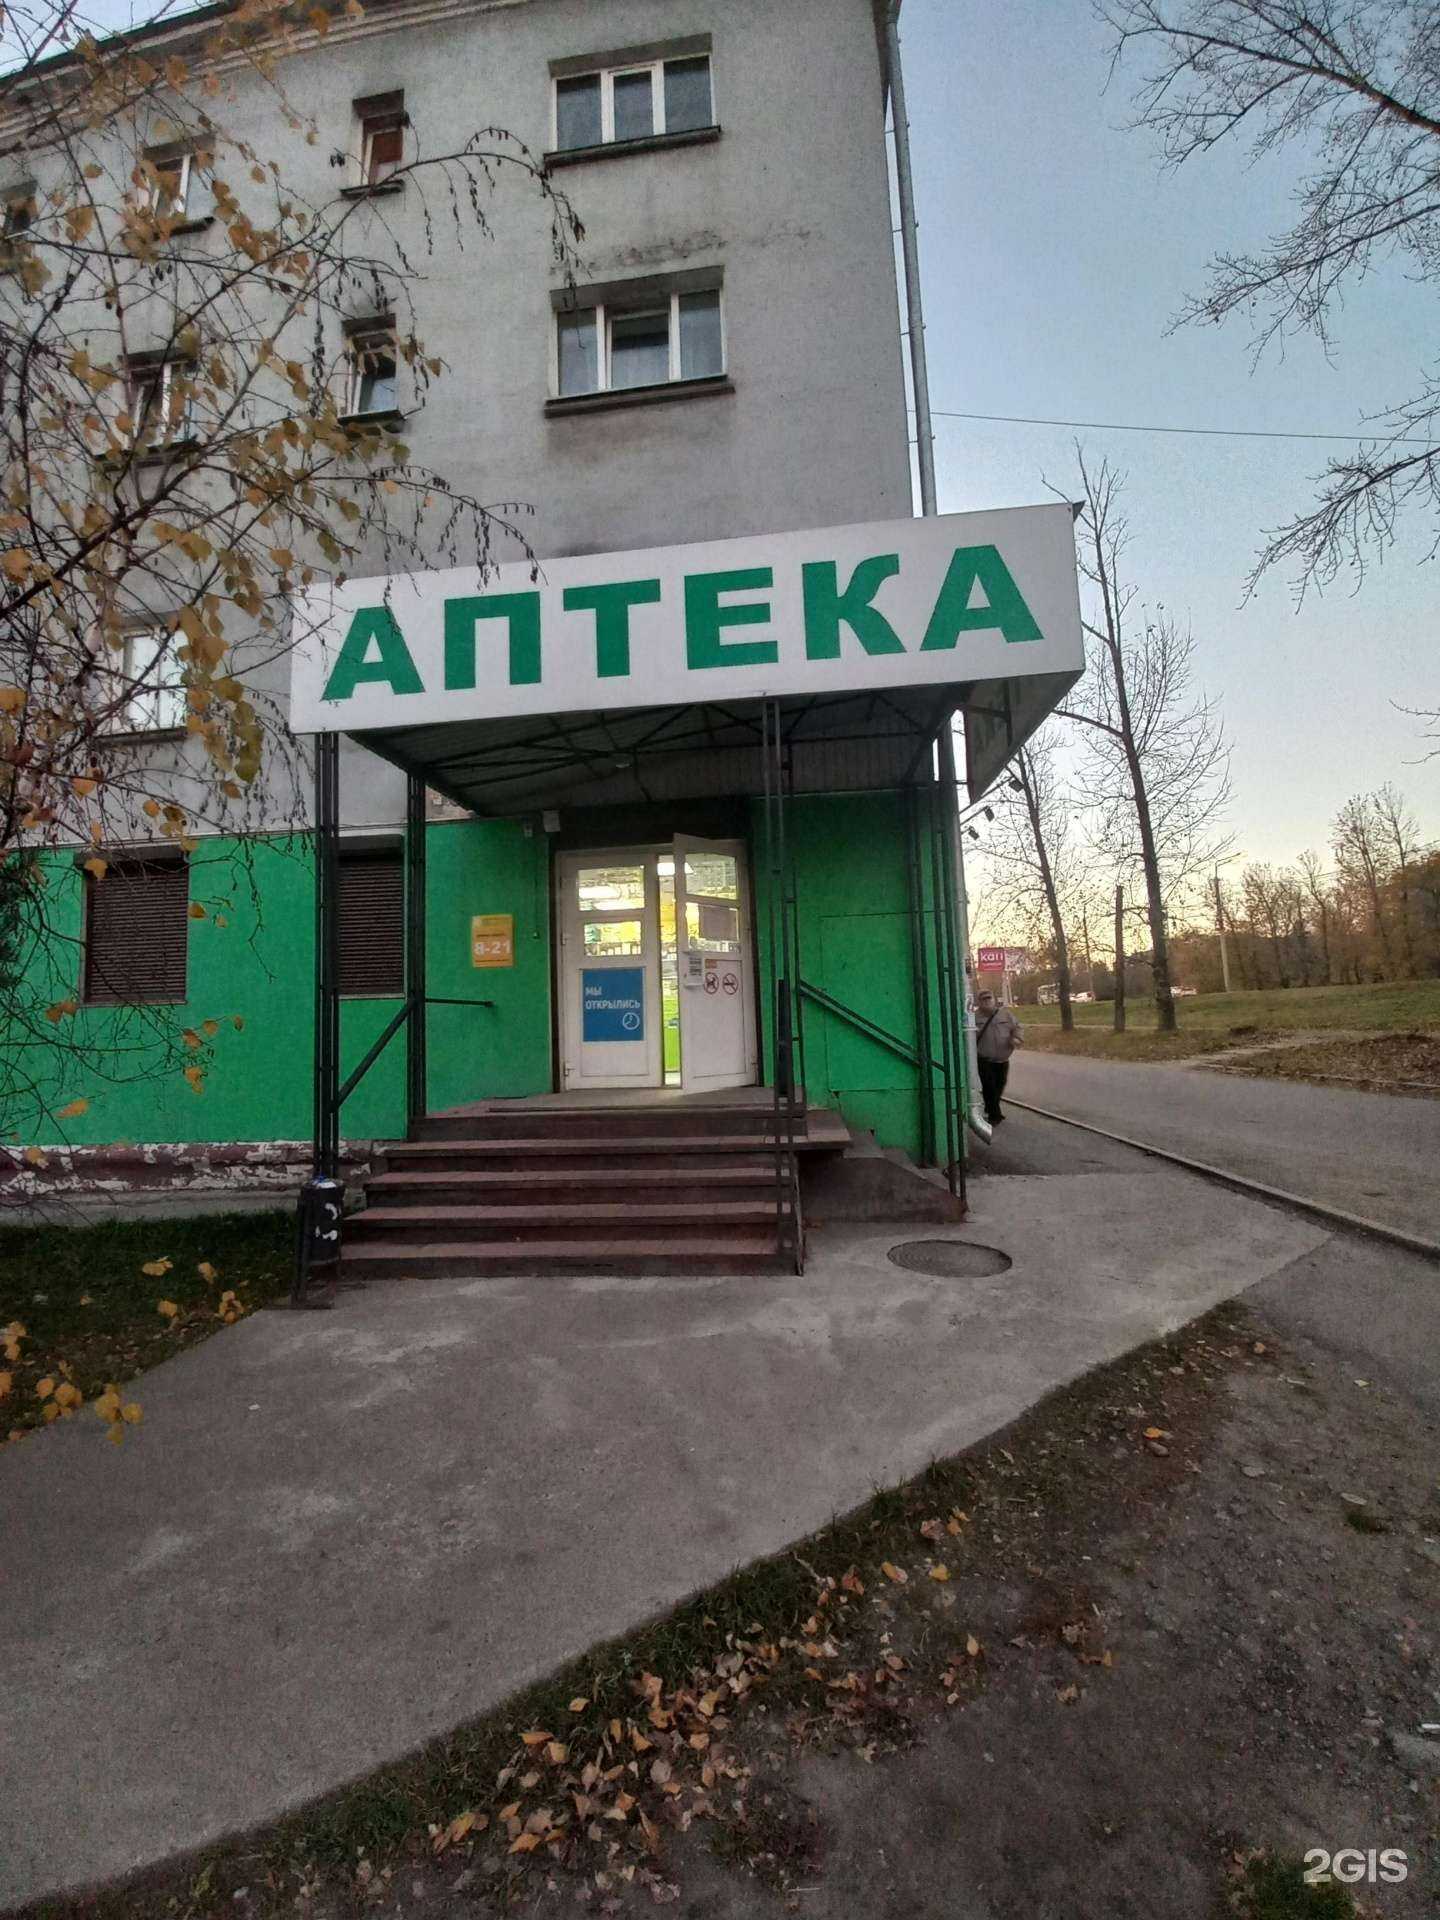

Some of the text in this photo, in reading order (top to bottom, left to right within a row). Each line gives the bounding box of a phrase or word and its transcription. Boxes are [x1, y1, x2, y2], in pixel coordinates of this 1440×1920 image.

[320, 544, 1044, 702] АПТЕКА
[585, 986, 602, 996] МЫ
[585, 999, 641, 1010] ОТКРЫЛИСЬ
